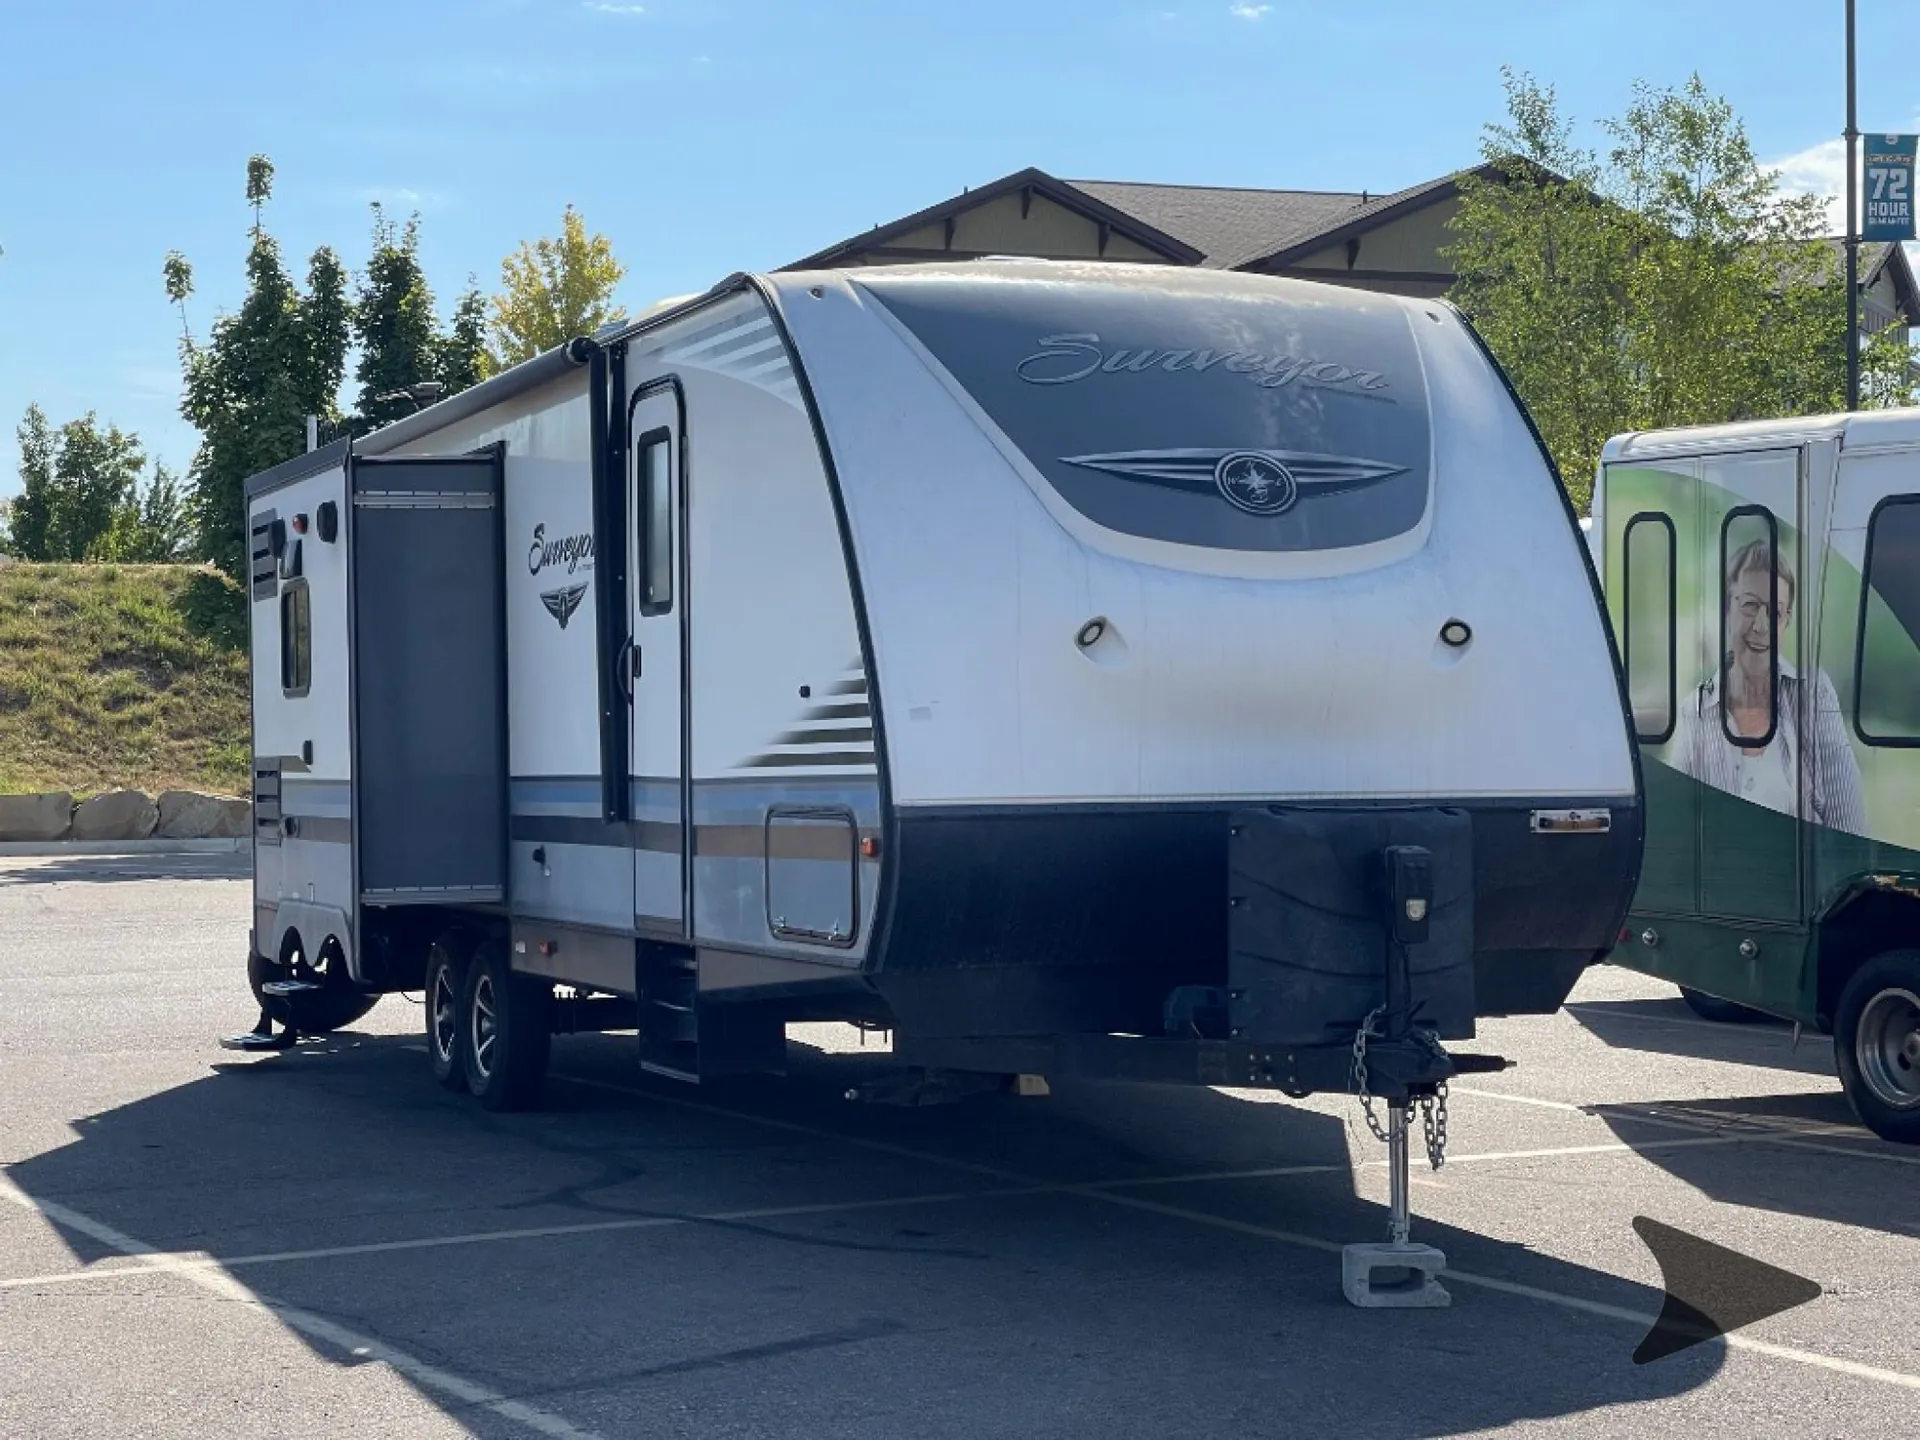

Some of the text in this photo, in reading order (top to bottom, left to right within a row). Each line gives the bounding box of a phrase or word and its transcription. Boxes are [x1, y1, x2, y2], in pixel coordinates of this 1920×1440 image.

[1868, 168, 1908, 199] 72
[1868, 202, 1909, 217] HOUR
[1015, 332, 1388, 390] Surveyor
